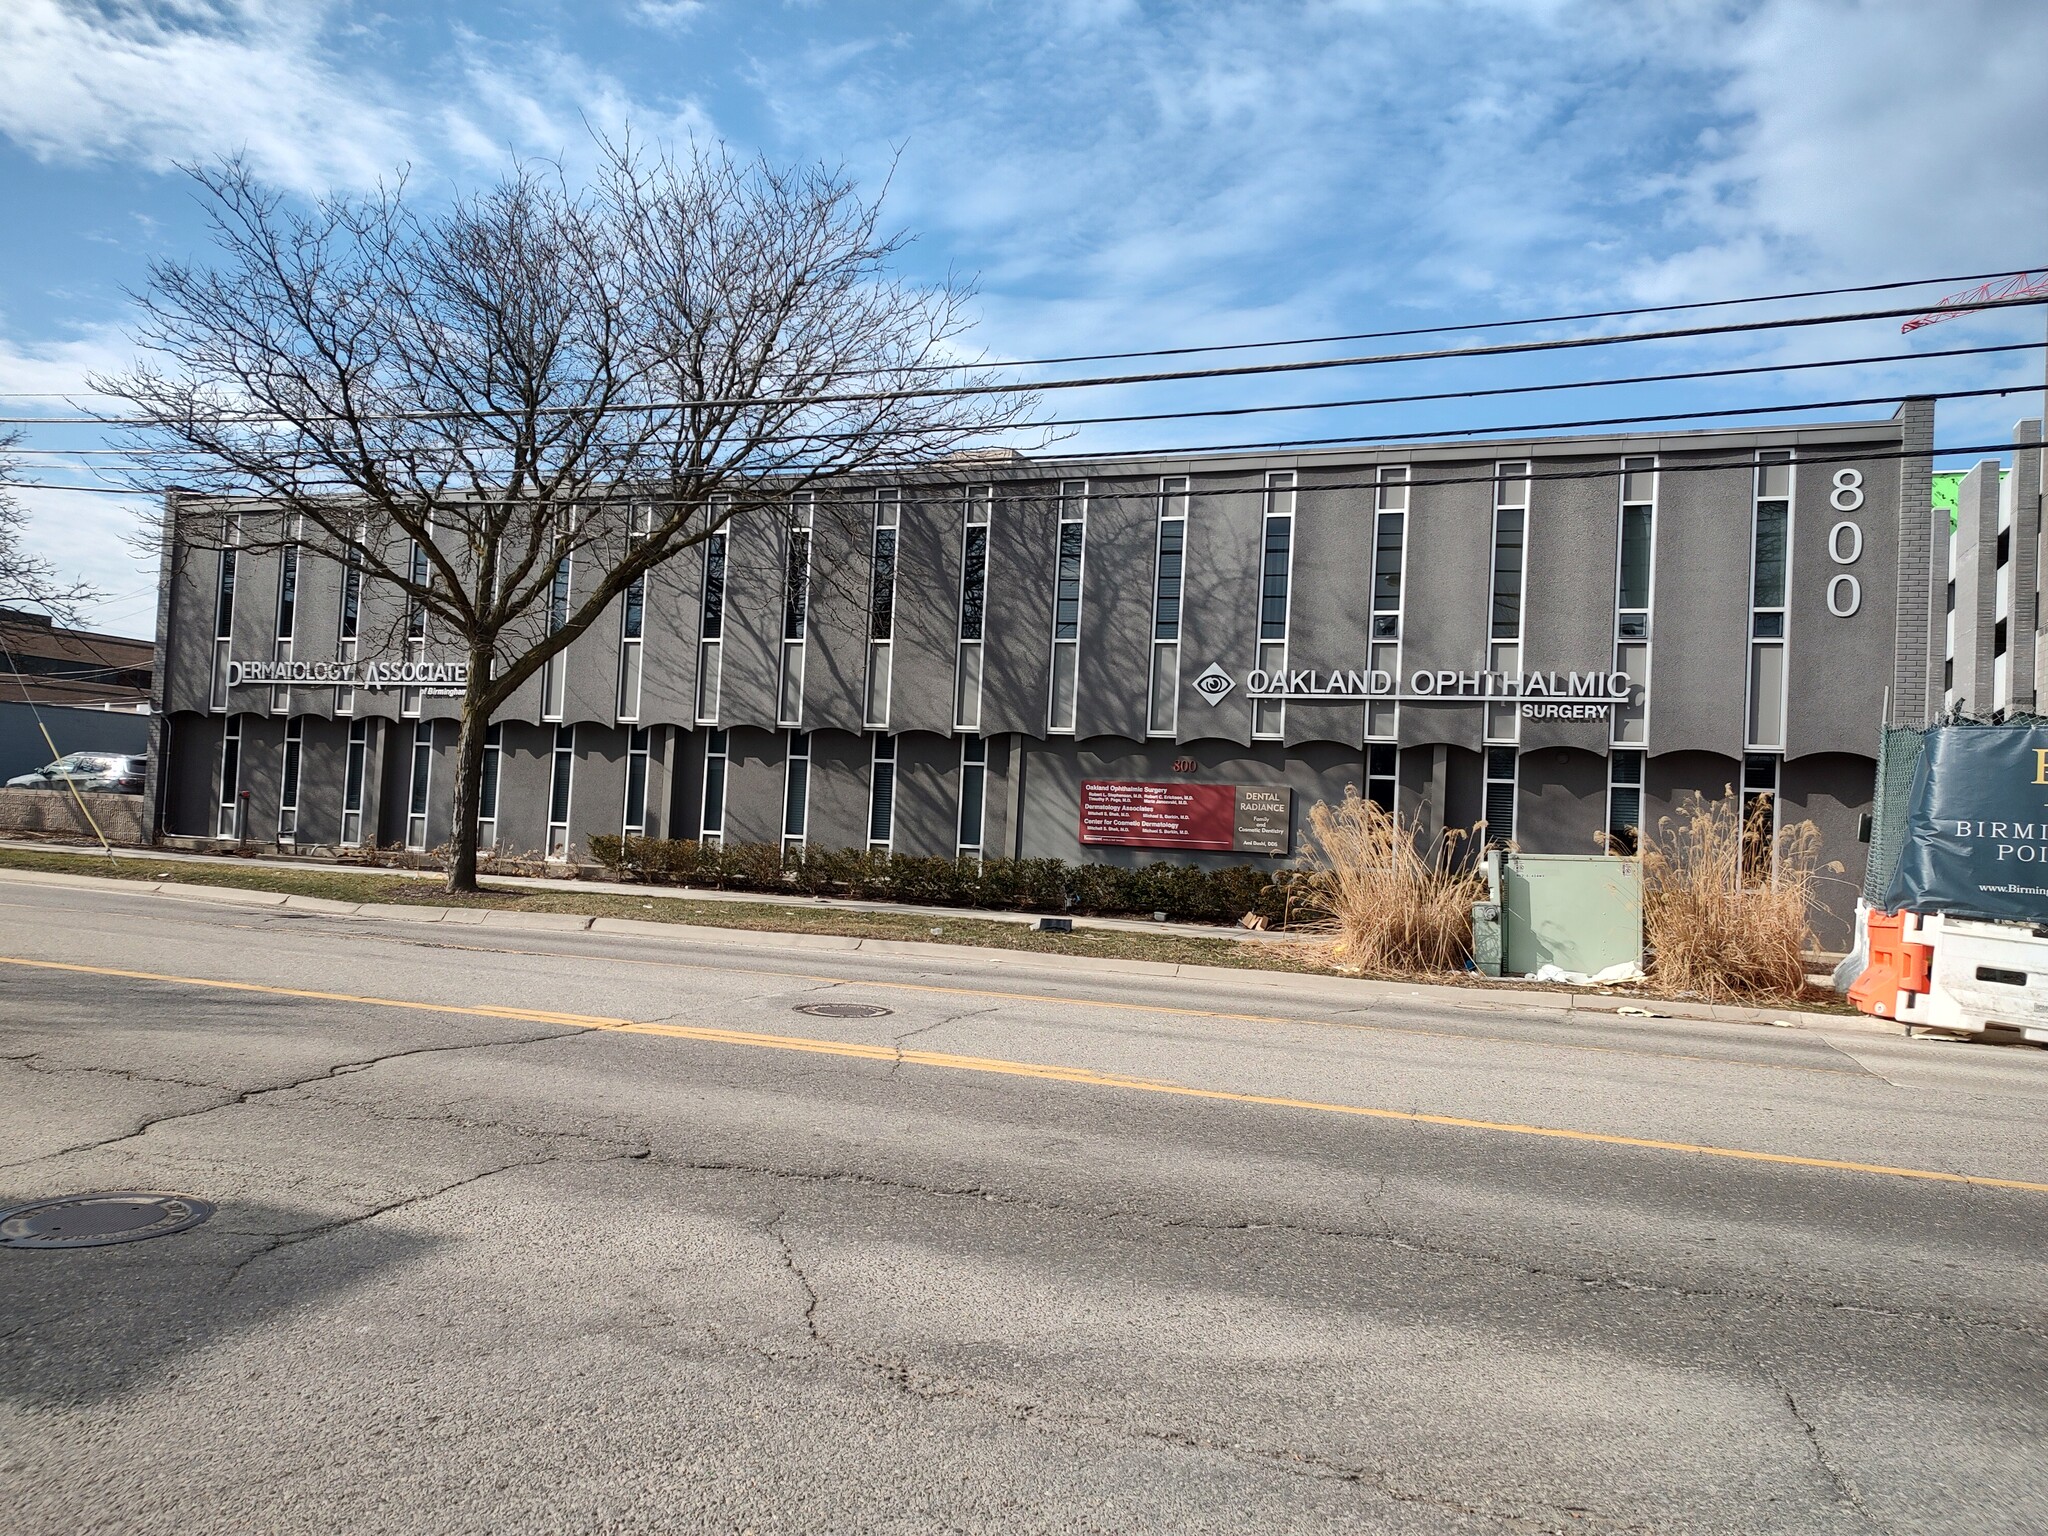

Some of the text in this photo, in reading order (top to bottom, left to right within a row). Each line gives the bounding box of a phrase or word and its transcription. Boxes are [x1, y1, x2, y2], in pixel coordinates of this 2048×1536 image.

[1827, 468, 1864, 617] 800
[364, 661, 469, 690] ASSOCIATE
[1246, 669, 1632, 698] OAKLAND OPHTHALMIC
[1521, 704, 1609, 719] SURGERY
[1173, 759, 1197, 772] 800
[1144, 786, 1168, 794] Surgery
[1246, 792, 1281, 801] DENTAL
[1084, 804, 1154, 813] Dermatology Associates
[1240, 802, 1285, 812] RADIANCE
[1141, 820, 1179, 829] Dermatology
[1261, 828, 1285, 836] Dentistry
[1996, 844, 2048, 863] POI
